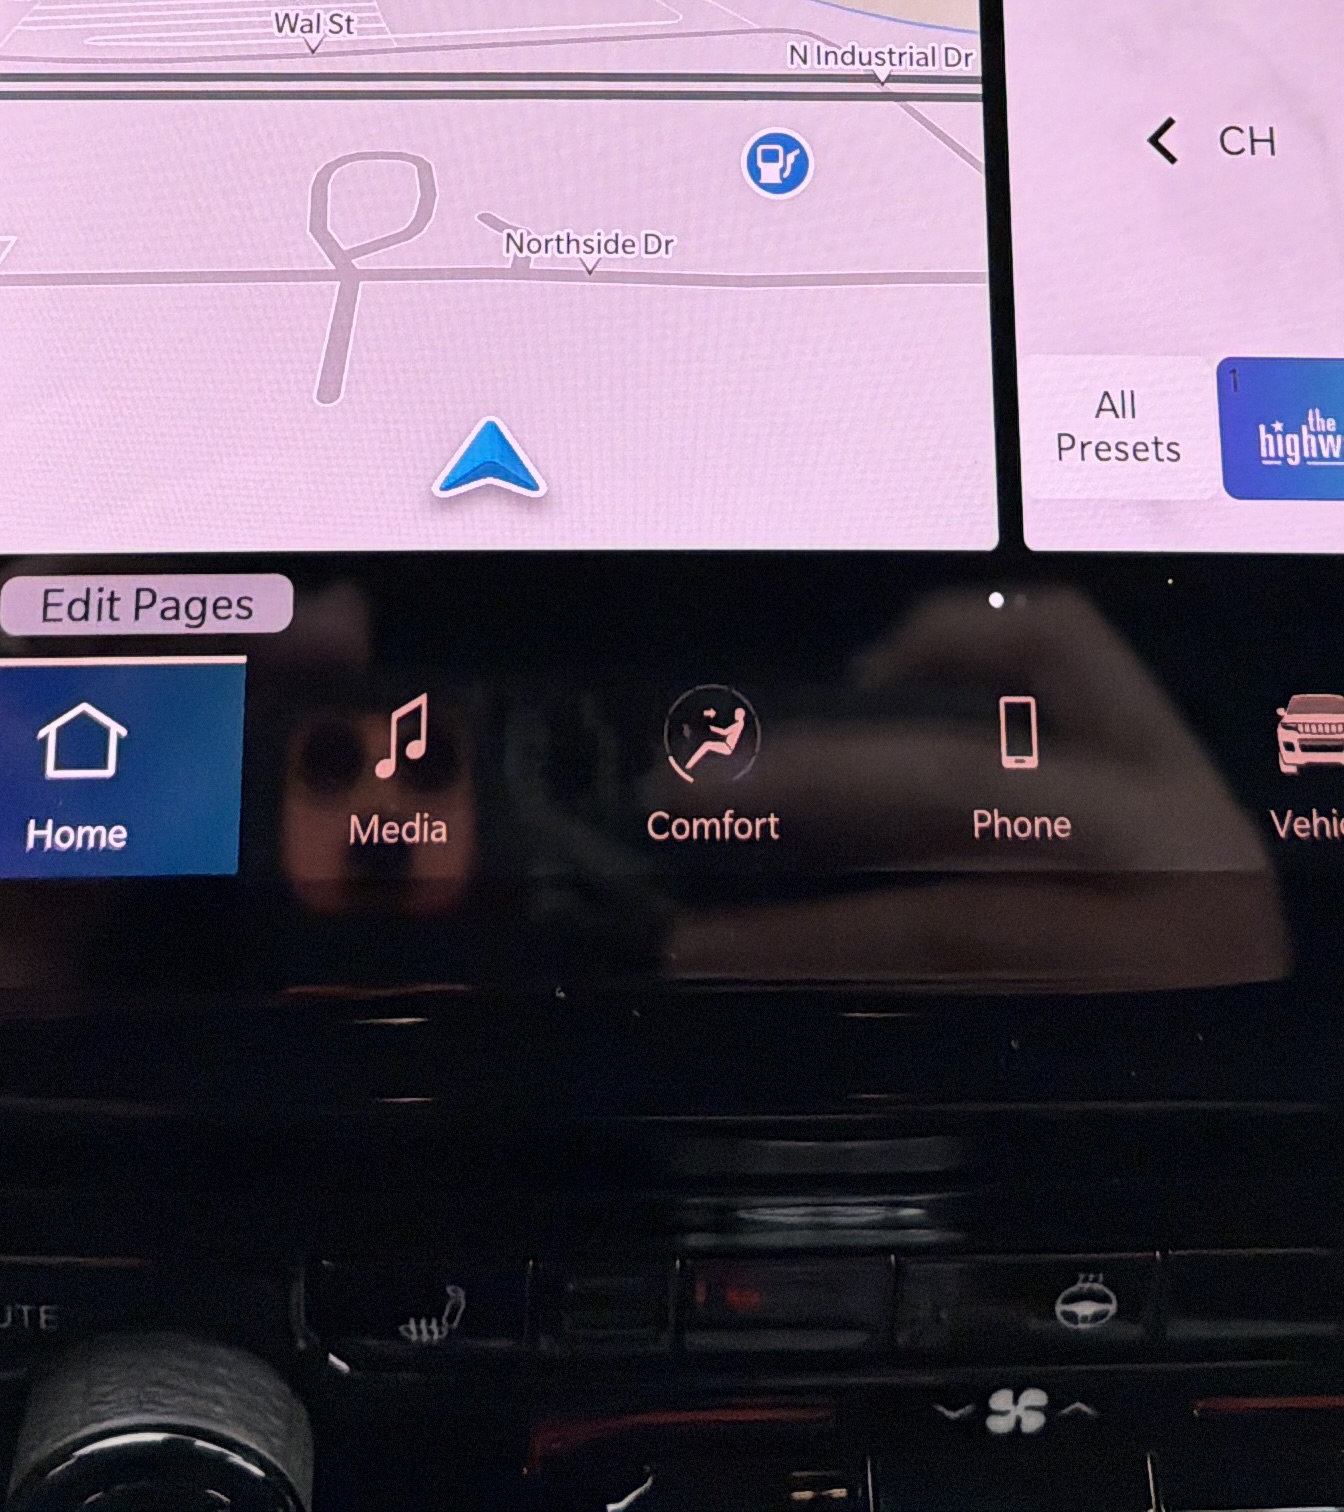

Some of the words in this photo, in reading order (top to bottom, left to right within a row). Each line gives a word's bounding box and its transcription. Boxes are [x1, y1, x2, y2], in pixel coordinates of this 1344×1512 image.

[274, 11, 321, 35] Wal
[327, 13, 354, 35] St
[789, 46, 807, 66] N
[814, 44, 936, 68] Industrial
[943, 47, 974, 68] Dr
[1219, 125, 1276, 157] CH
[506, 232, 635, 257] Northside
[642, 233, 674, 257] Dr
[1095, 390, 1136, 420] All
[1308, 408, 1336, 432] the
[1056, 433, 1181, 467] Presets
[41, 587, 121, 624] Edit
[133, 587, 254, 630] Pages
[25, 818, 128, 852] Home
[348, 813, 449, 846] Media
[647, 808, 780, 844] Comfort
[973, 809, 1071, 840] Phone
